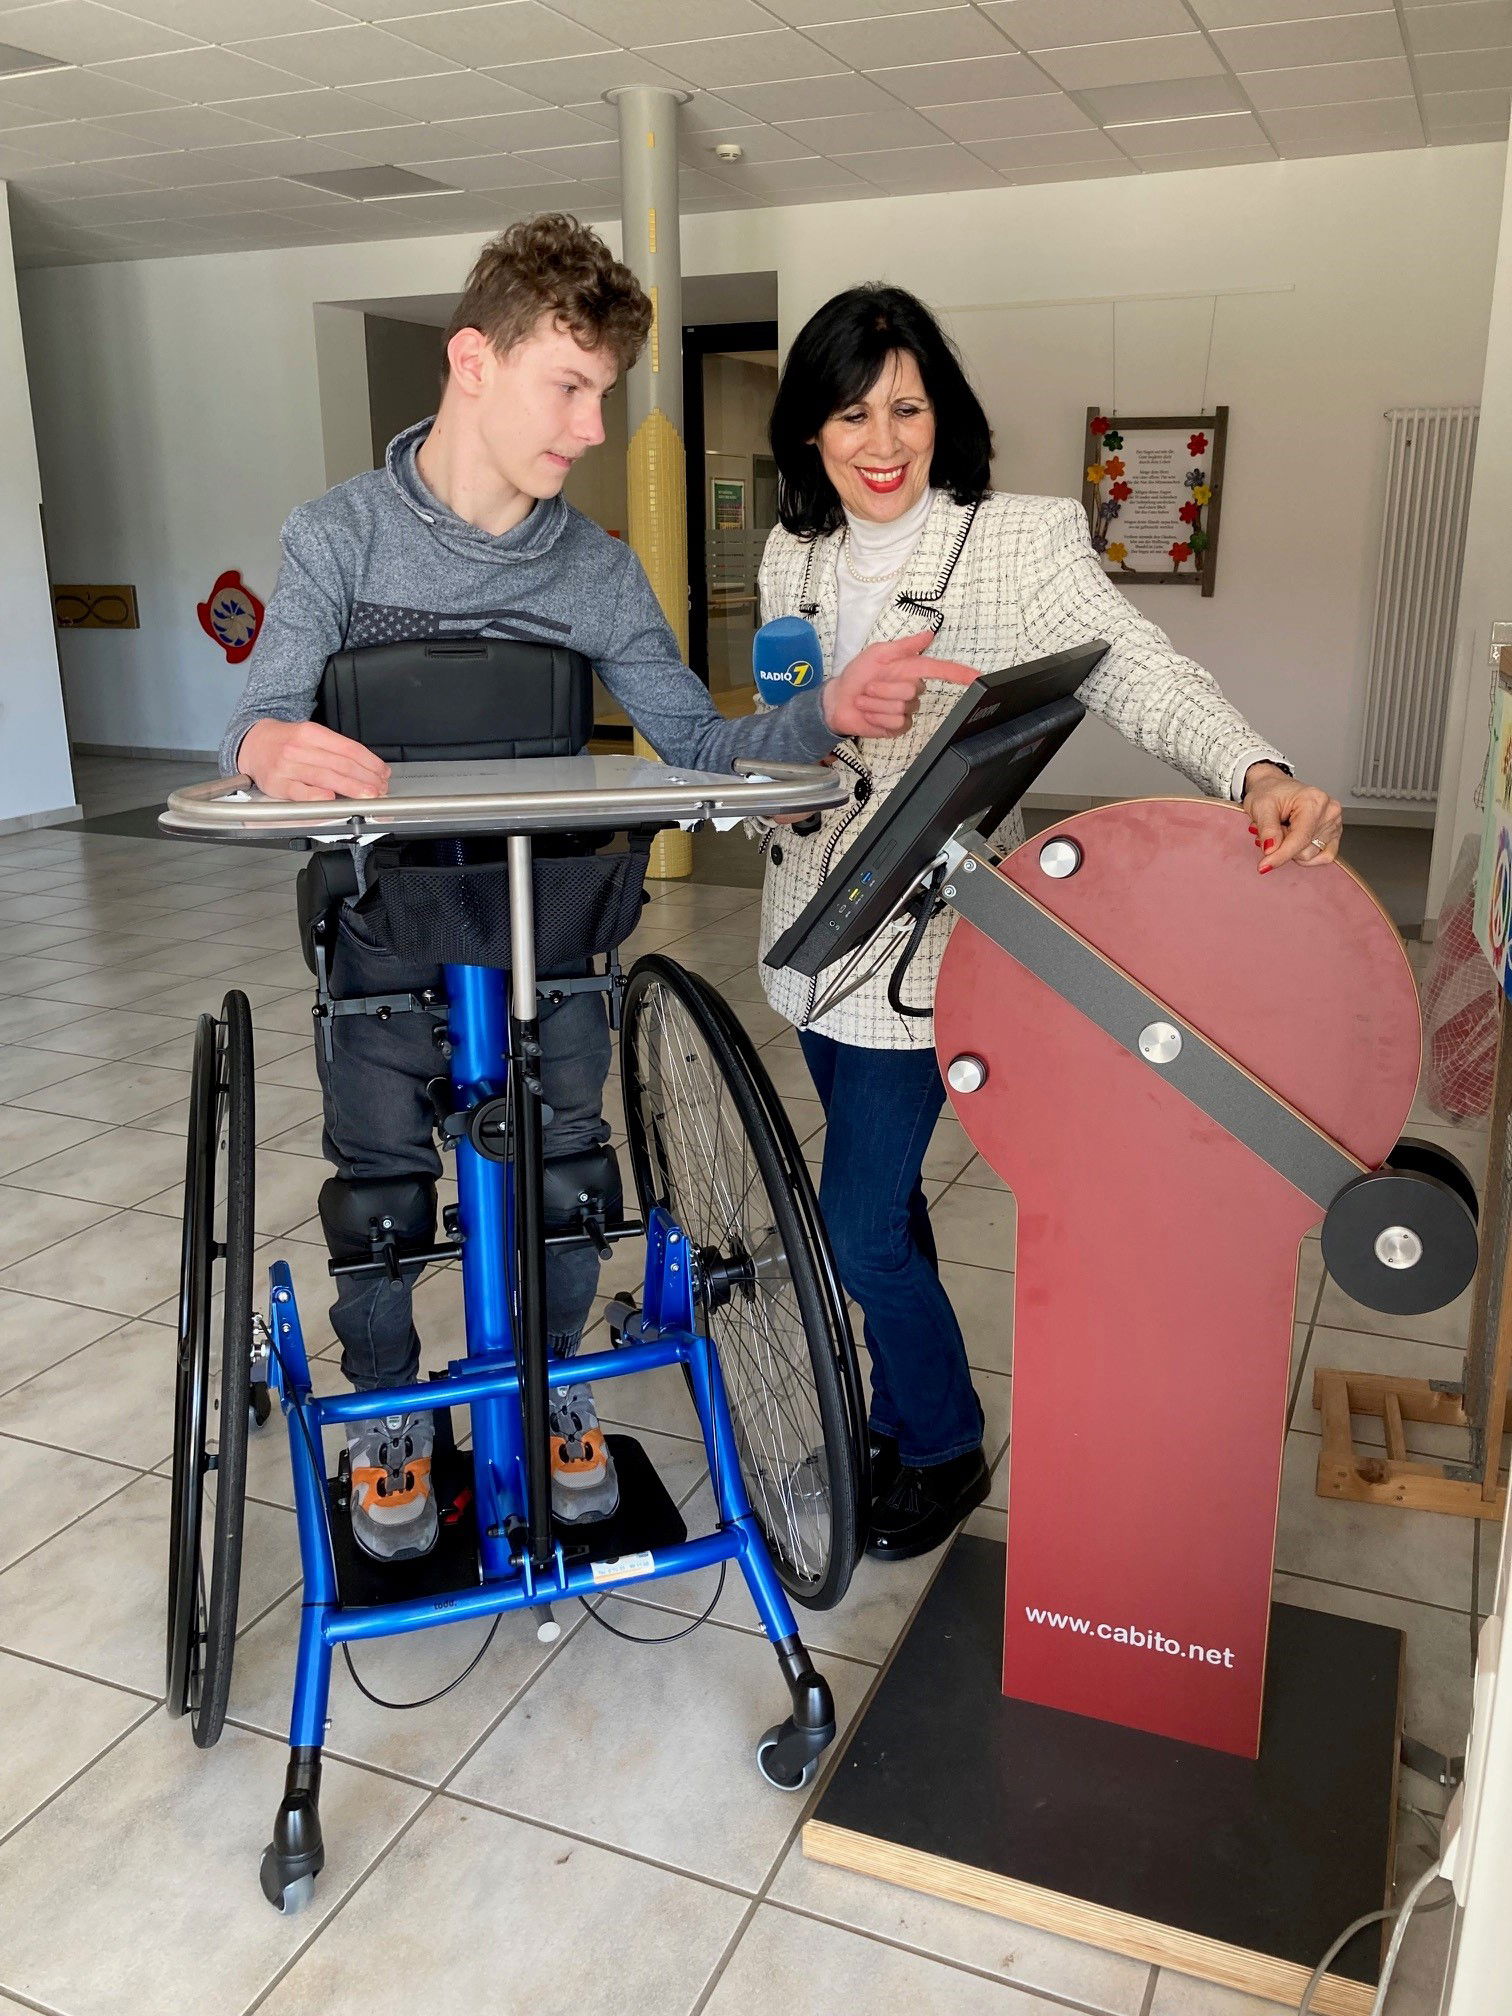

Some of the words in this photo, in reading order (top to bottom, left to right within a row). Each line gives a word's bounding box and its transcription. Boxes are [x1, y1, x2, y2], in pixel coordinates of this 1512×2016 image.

[760, 670, 792, 682] RADIO
[793, 663, 810, 686] 7
[1024, 1605, 1236, 1669] www.cabito.net
